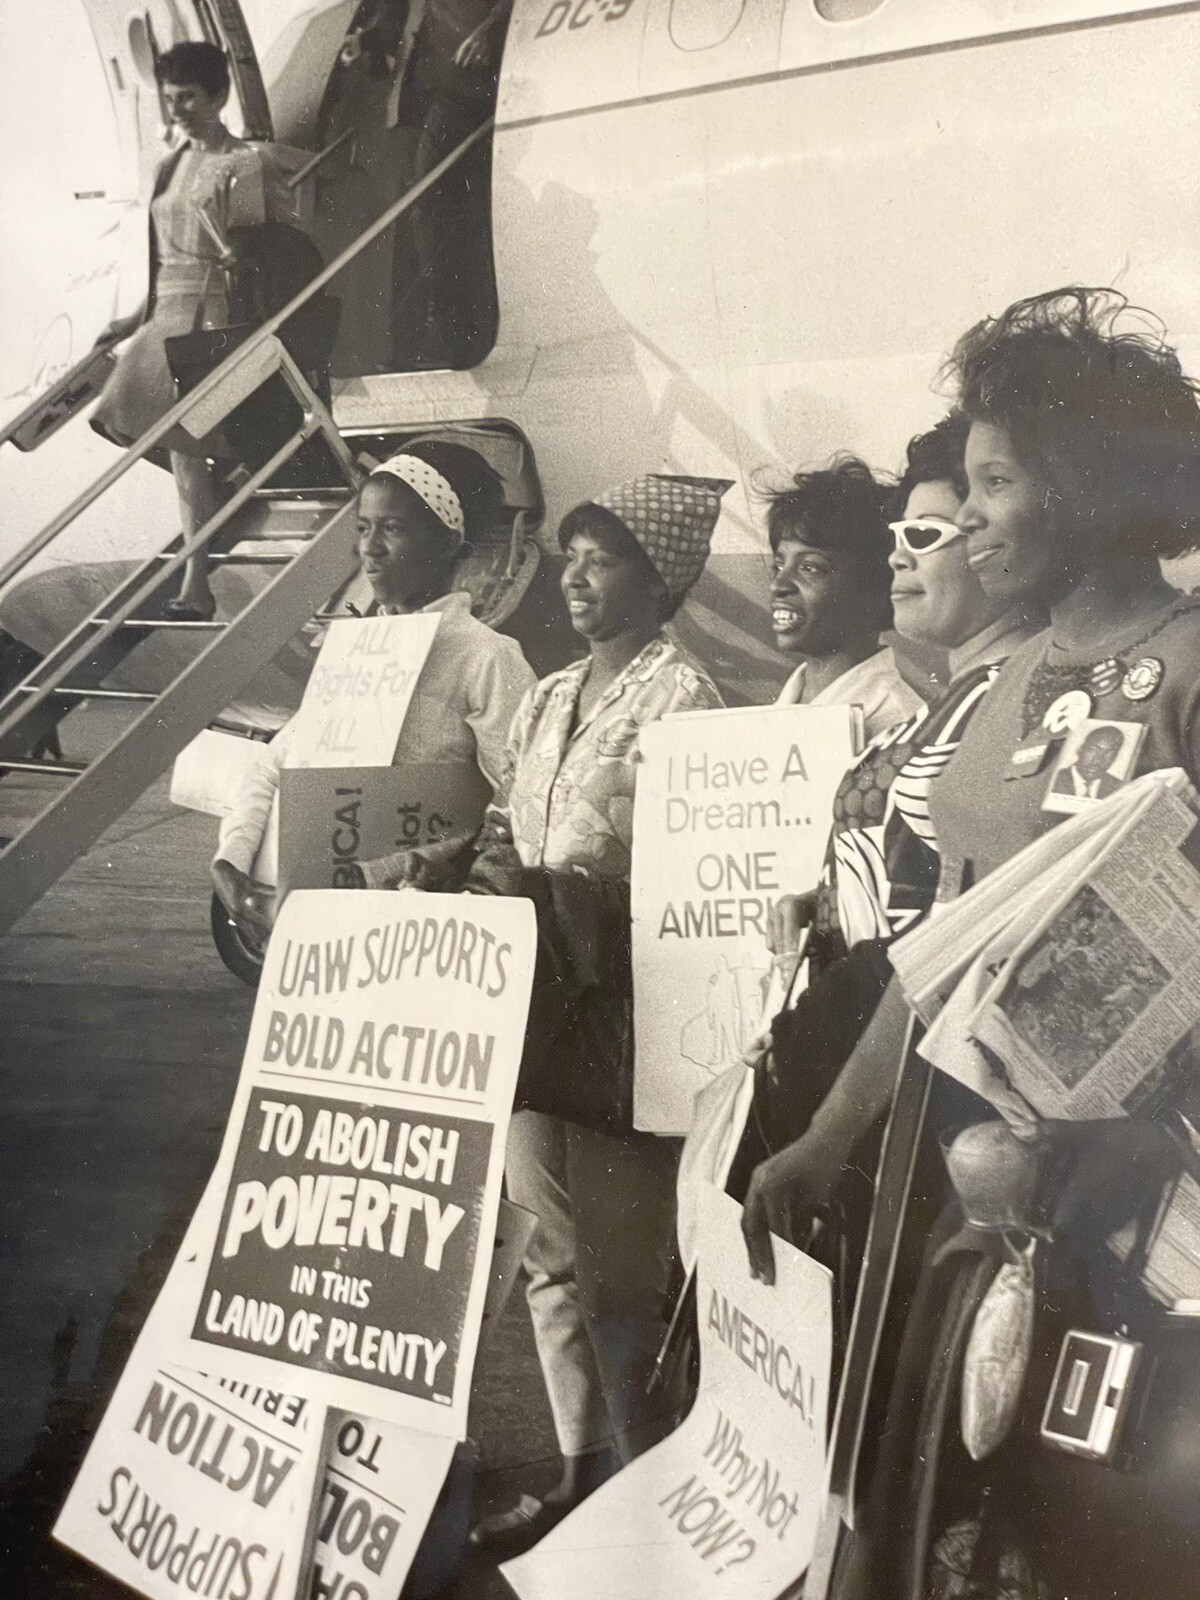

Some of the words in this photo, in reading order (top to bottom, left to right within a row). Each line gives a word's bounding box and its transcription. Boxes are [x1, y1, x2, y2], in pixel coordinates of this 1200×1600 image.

[347, 622, 392, 656] ALL
[374, 660, 415, 696] For
[315, 716, 357, 753] ALL
[667, 757, 673, 792] I
[685, 752, 769, 790] Have
[781, 744, 809, 782] A
[666, 797, 812, 834] Dream...
[697, 851, 780, 891] ONE
[278, 936, 355, 997] UAW
[357, 917, 512, 998] SUPPORTS
[262, 1010, 345, 1070] BOLD
[348, 1020, 495, 1092] ACTION
[259, 1100, 304, 1157] TO
[304, 1109, 460, 1185] ABOLISH
[222, 1175, 466, 1271] POVERTY
[290, 1264, 318, 1296] IN
[321, 1270, 373, 1308] THIS
[205, 1289, 286, 1346] LAND
[287, 1309, 323, 1355] OF
[325, 1316, 447, 1387] PLENTY
[707, 1288, 816, 1429] AMERICA!
[133, 1380, 296, 1509] ACTION
[337, 1419, 385, 1473] TO
[703, 1408, 758, 1498] Why
[747, 1456, 799, 1540] Not
[97, 1466, 268, 1600] SUPPORTS
[319, 1480, 402, 1577] BOL
[658, 1474, 757, 1575] NOW?
